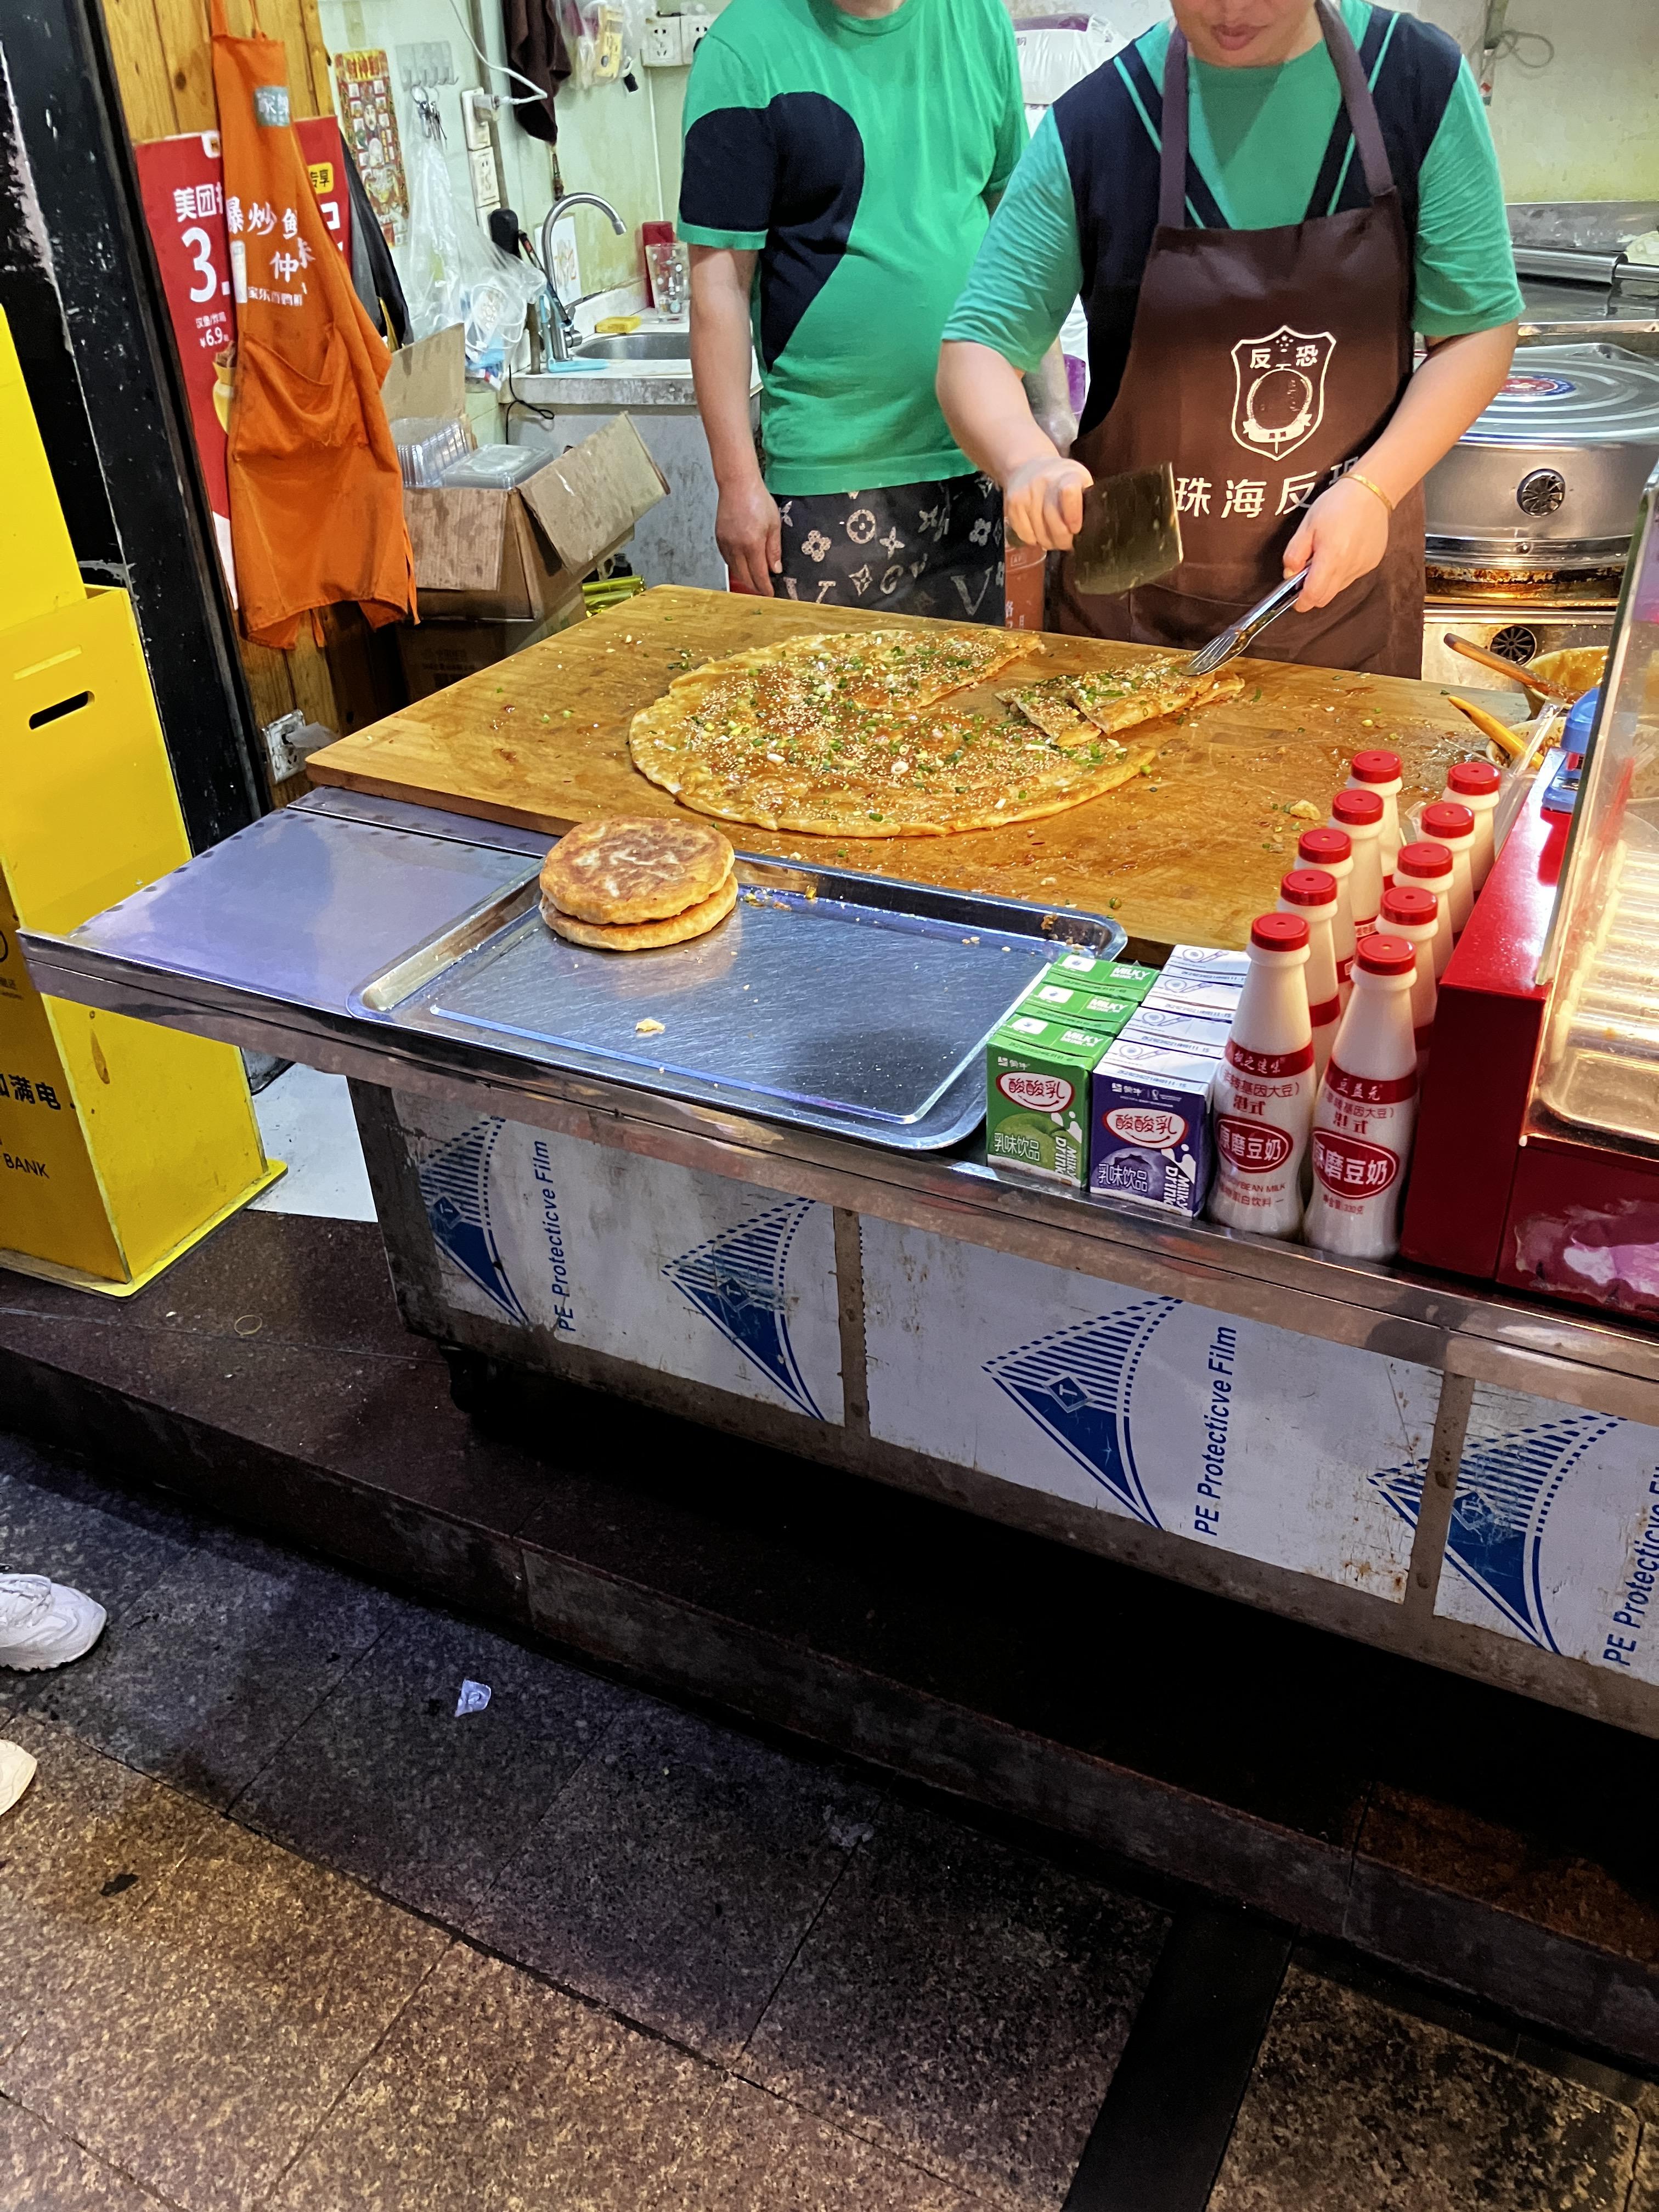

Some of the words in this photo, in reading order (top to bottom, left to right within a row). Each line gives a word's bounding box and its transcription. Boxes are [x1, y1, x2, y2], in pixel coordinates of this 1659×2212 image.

[1008, 1077, 1065, 1099] 酸酸乳
[1115, 1114, 1177, 1135] 酸酸乳
[994, 1132, 1040, 1161] 乳味饮品
[1220, 1125, 1281, 1161] 原磨豆奶
[3, 1153, 50, 1178] BANK
[533, 1141, 553, 1183] Film
[1098, 1163, 1148, 1192] 乳味饮品
[1313, 1141, 1387, 1186] 原磨豆奶
[555, 1305, 575, 1332] PE
[1209, 1327, 1237, 1375] Film
[1198, 1380, 1232, 1499] Protecticve
[1195, 1505, 1219, 1536] PE
[1602, 1634, 1637, 1666] PE
